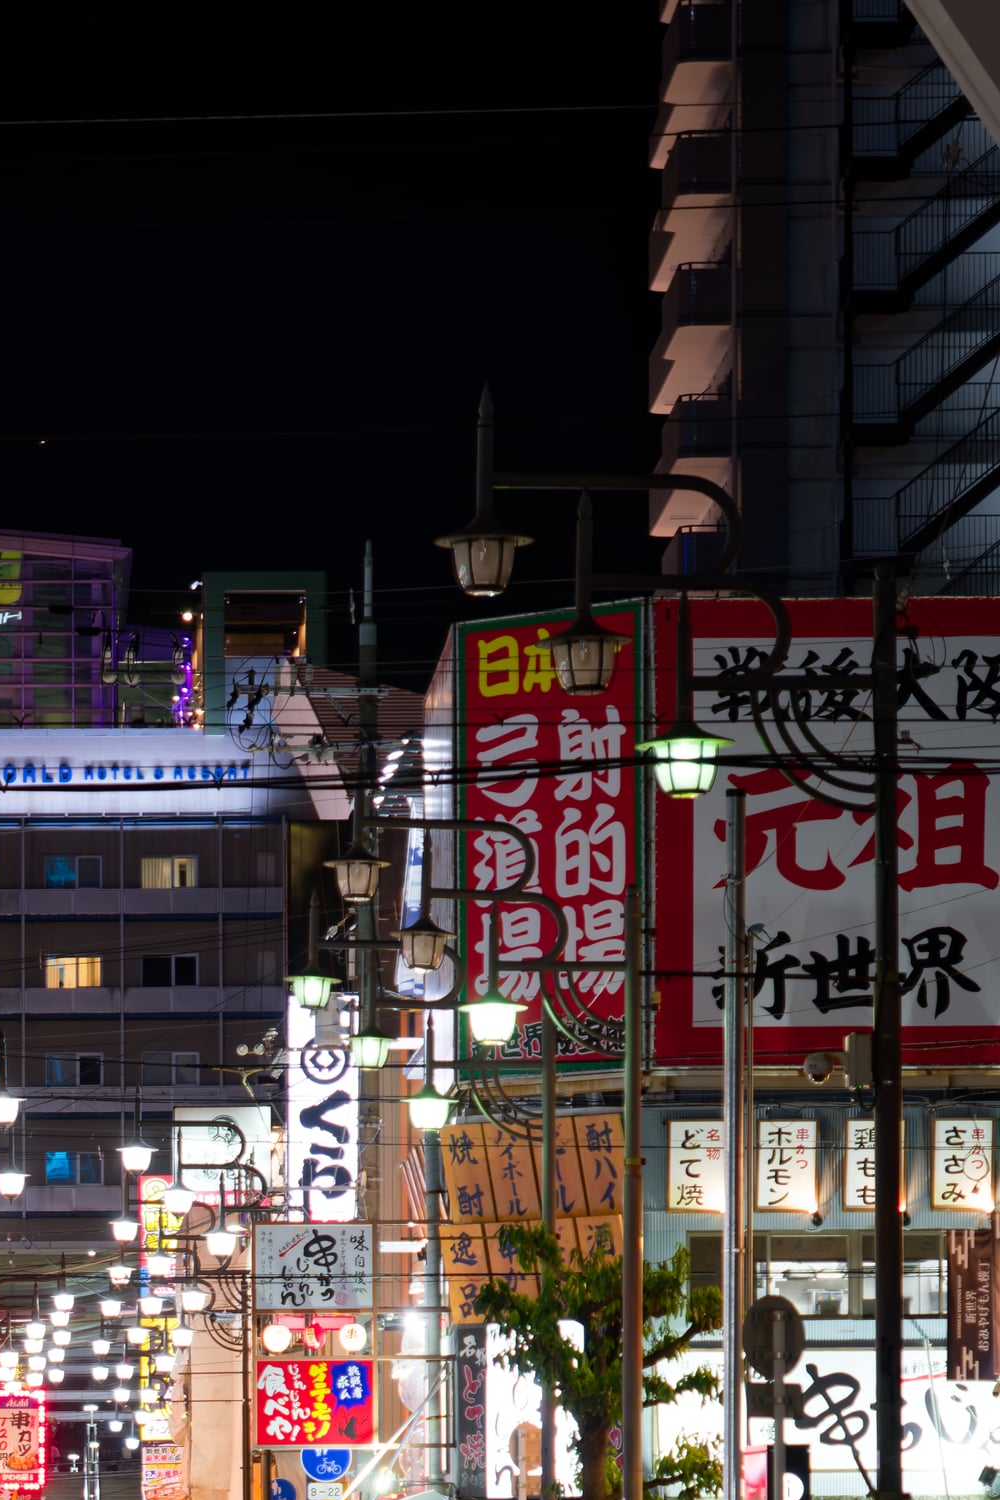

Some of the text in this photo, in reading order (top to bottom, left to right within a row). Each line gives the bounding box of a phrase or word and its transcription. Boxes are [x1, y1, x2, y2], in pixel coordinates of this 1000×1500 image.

[477, 628, 622, 698] 日本
[84, 765, 145, 781] HOTEL
[554, 704, 627, 996] 射的場
[450, 1130, 485, 1218] 焼酎
[494, 1130, 529, 1217] ハイボール
[585, 1120, 618, 1210] 酎ハイ
[676, 1128, 704, 1207] どて焼
[706, 1128, 720, 1160] 名物
[767, 1127, 793, 1206] ホルモン
[795, 1128, 810, 1170] 串かつ
[942, 1126, 967, 1203] ささみ
[971, 1127, 985, 1170] 串かつ
[965, 1289, 977, 1324] 新世界
[10, 1411, 32, 1457] 串カツ
[311, 1487, 340, 1497] 9-22
